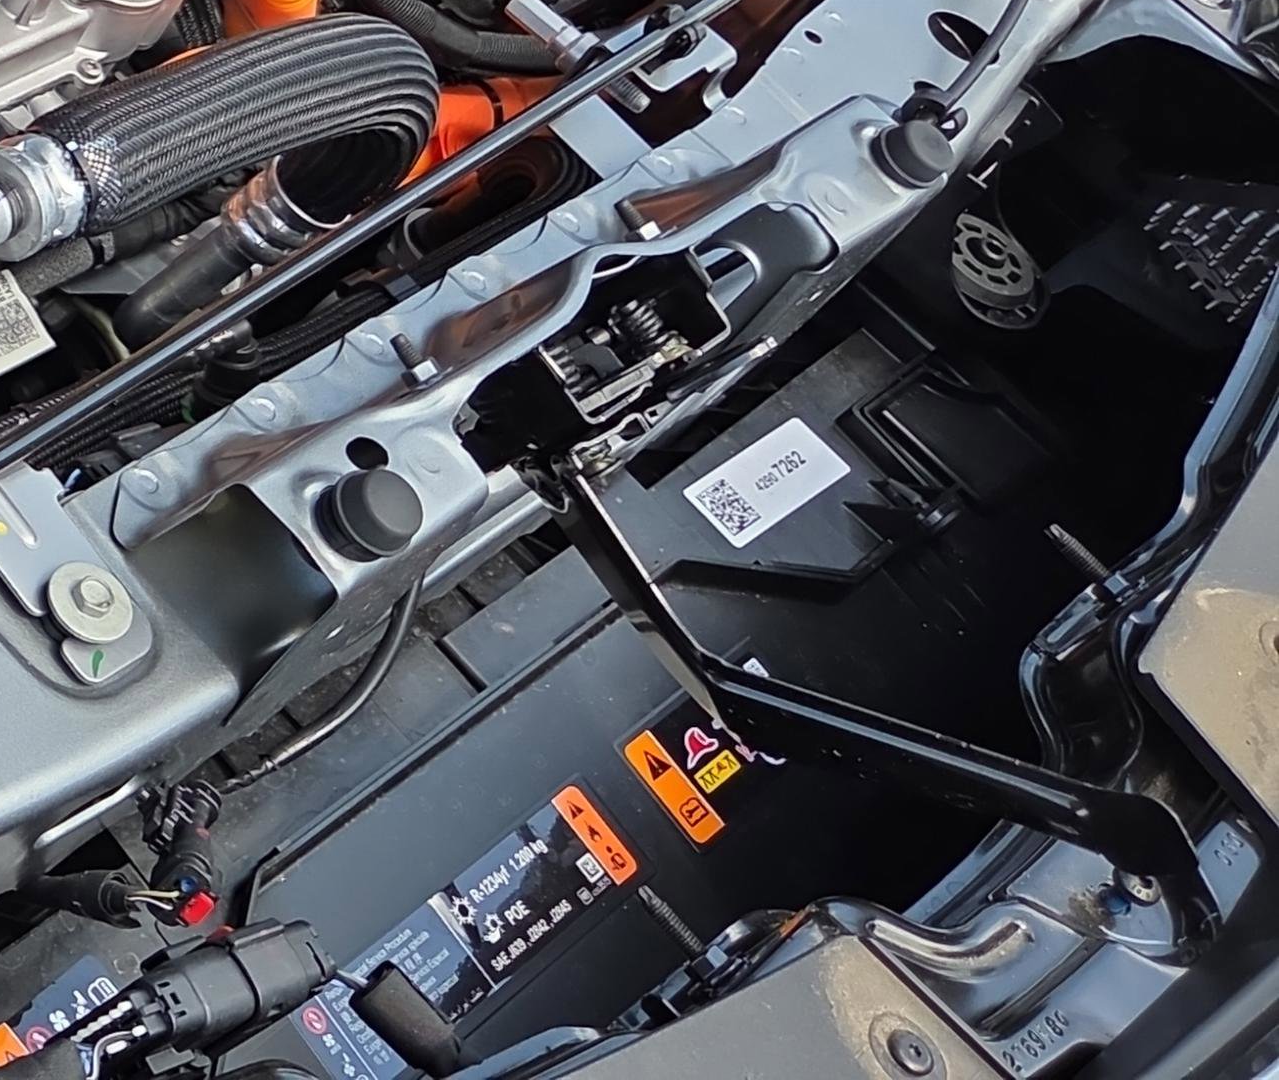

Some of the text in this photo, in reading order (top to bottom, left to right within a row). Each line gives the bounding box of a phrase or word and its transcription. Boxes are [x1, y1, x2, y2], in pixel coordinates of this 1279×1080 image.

[771, 450, 807, 478] 7262
[469, 839, 549, 903] R-1234yf 1.200 kg
[504, 900, 531, 925] POE
[491, 951, 512, 972] SAE
